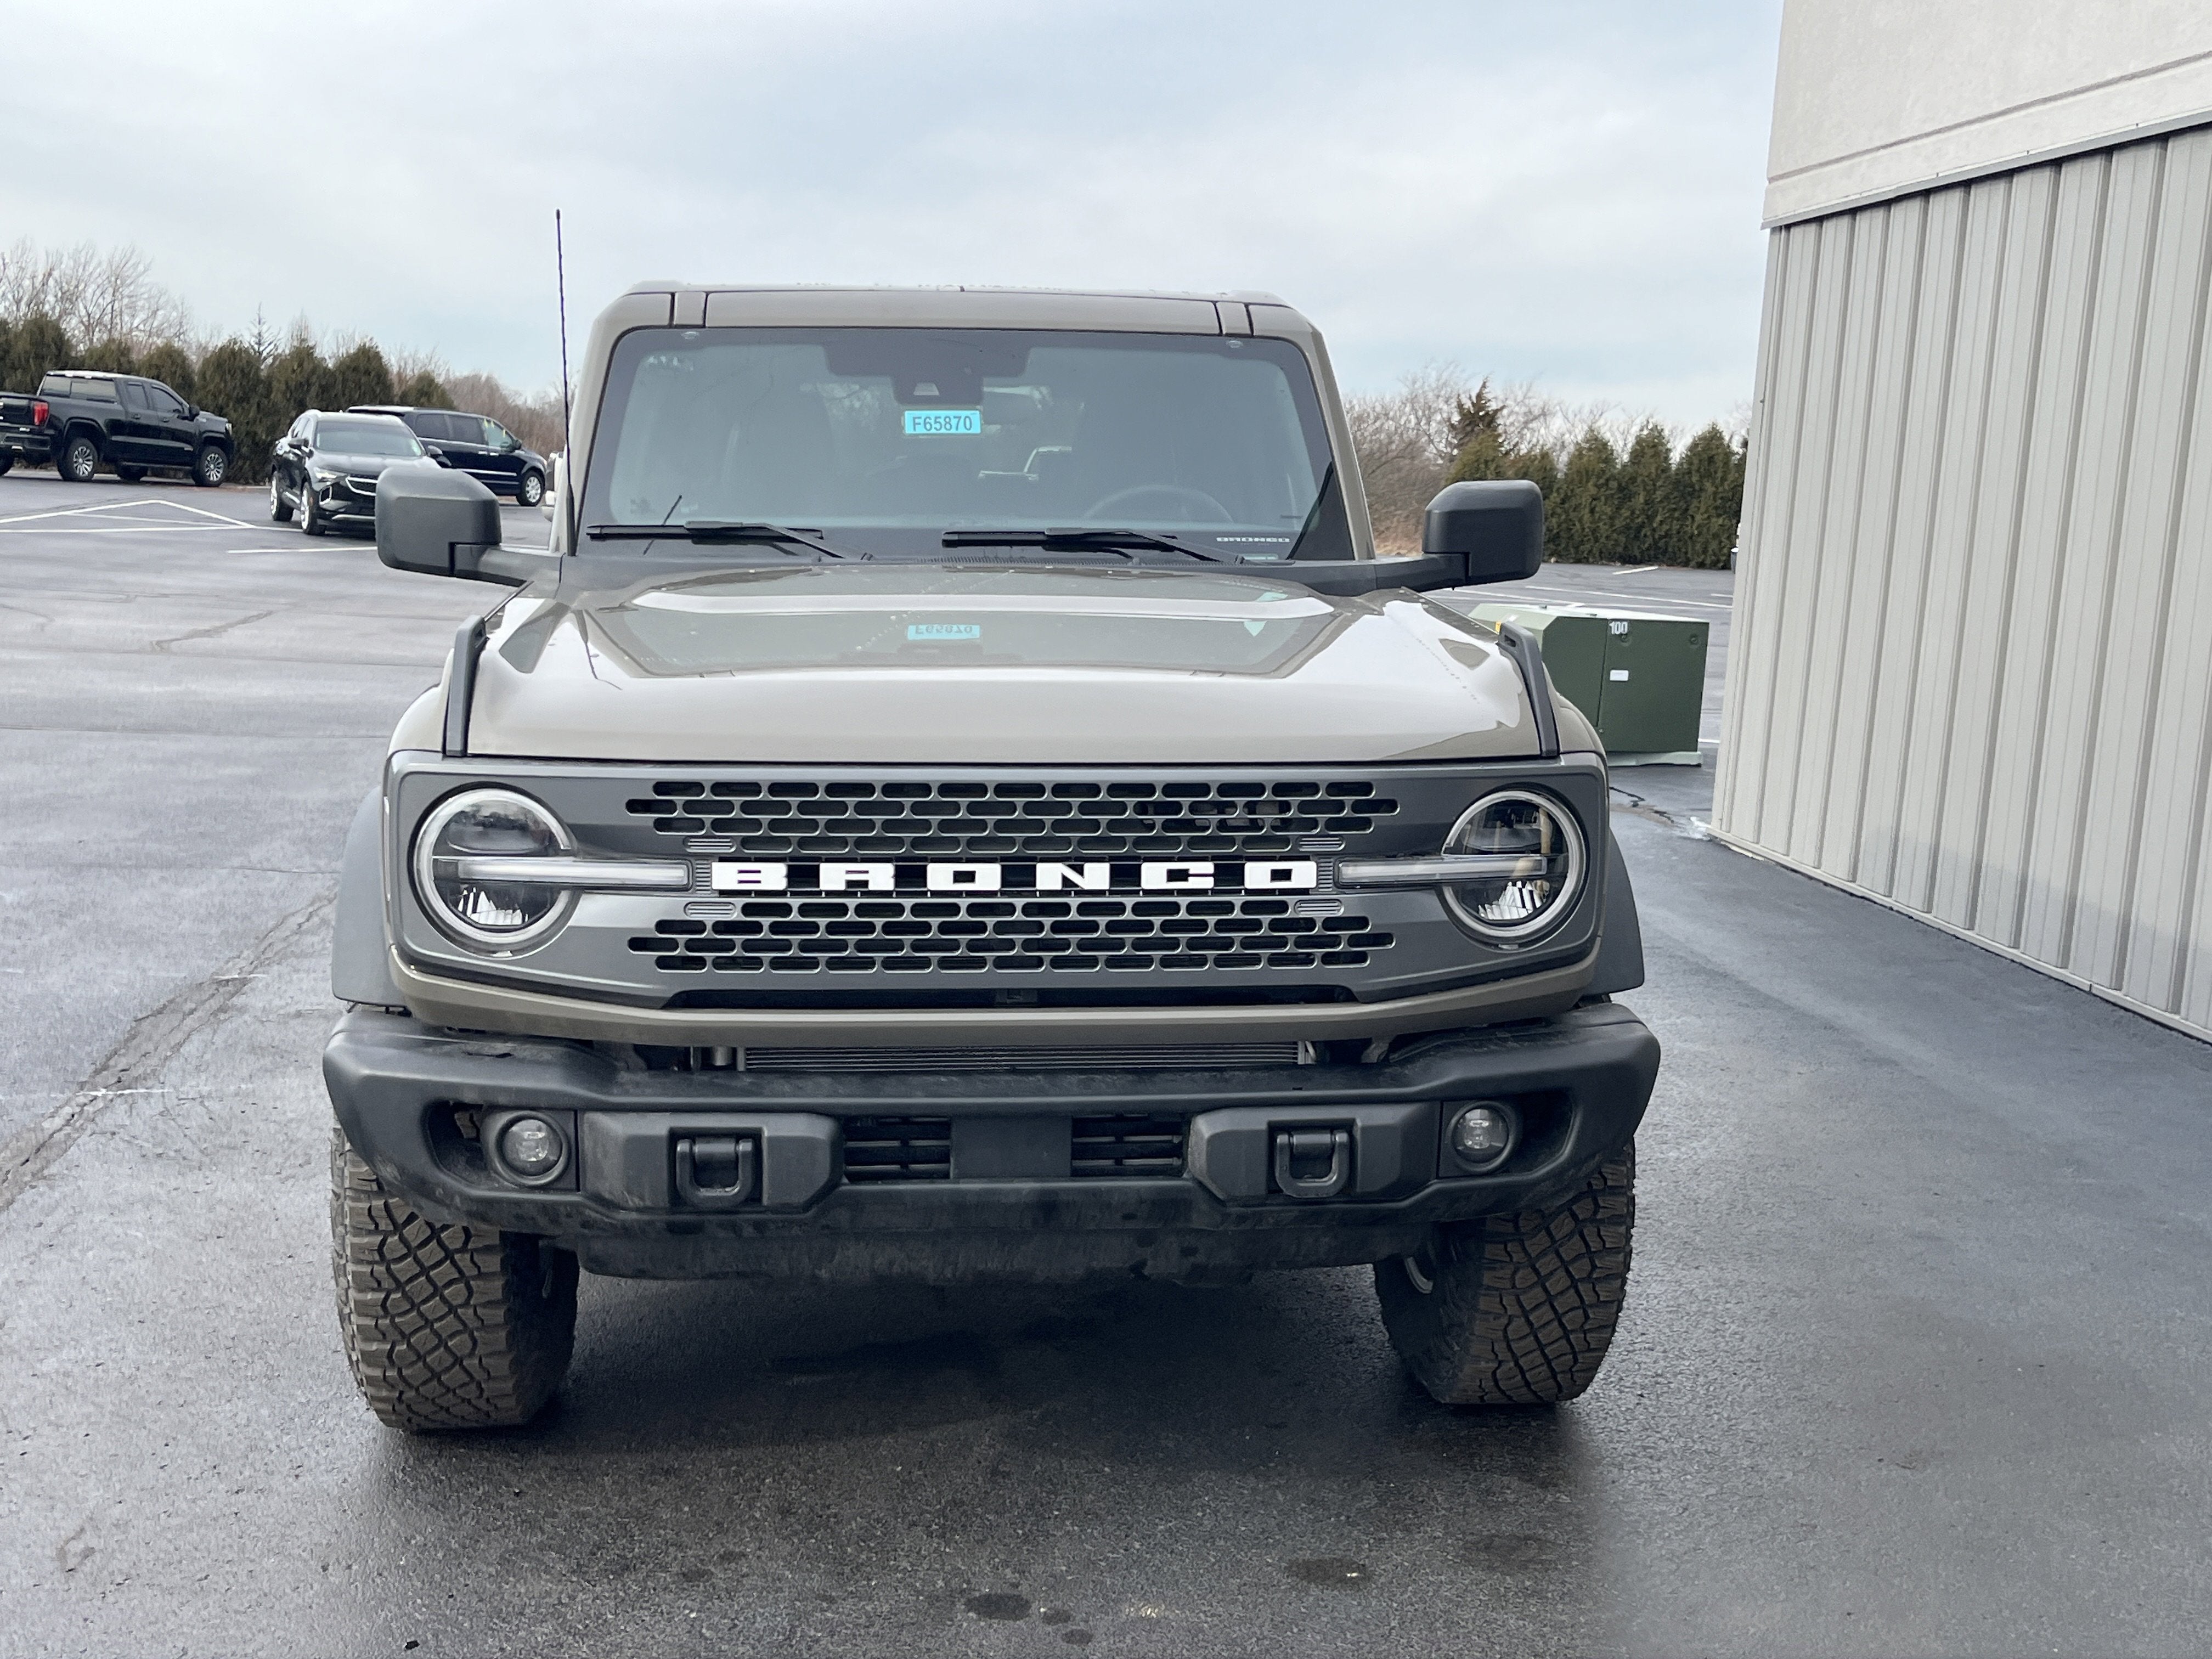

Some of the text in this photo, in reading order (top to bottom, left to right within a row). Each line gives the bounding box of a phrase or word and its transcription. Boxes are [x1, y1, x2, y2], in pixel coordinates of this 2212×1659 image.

[912, 415, 973, 432] F65870
[1609, 621, 1628, 635] 100
[712, 861, 1317, 890] BRONCO
